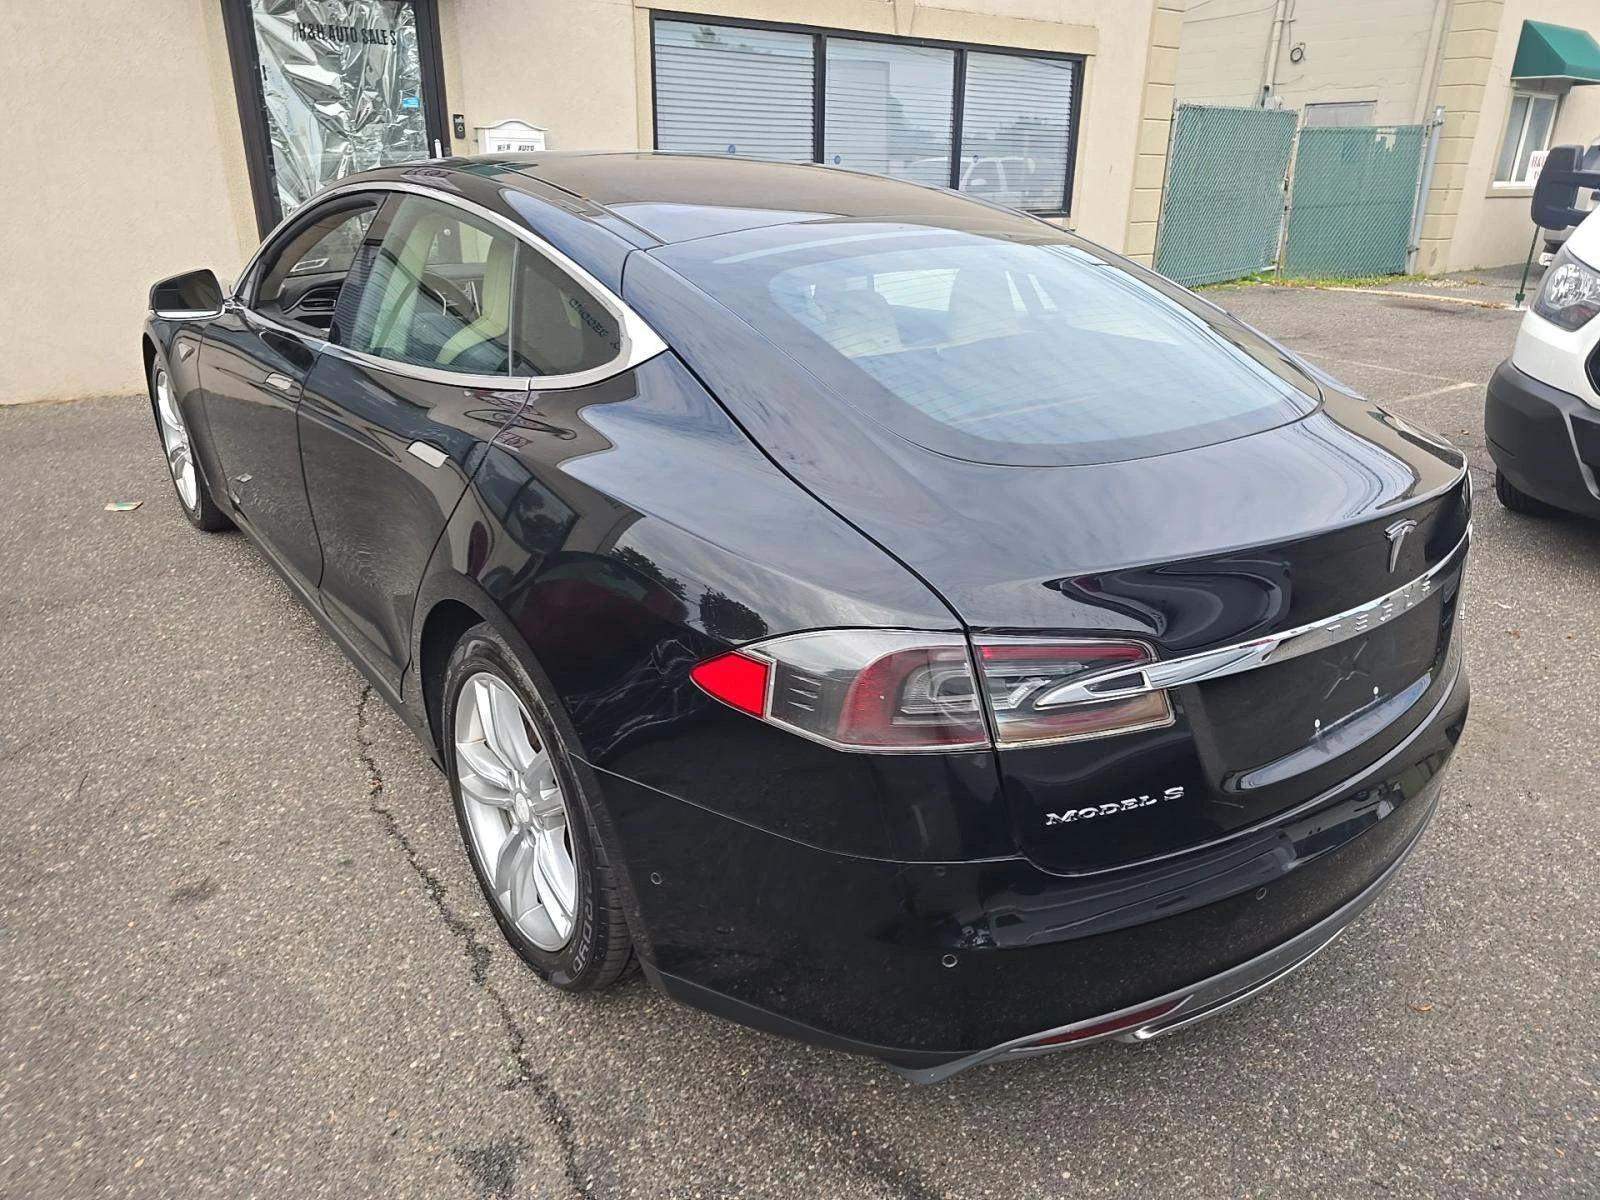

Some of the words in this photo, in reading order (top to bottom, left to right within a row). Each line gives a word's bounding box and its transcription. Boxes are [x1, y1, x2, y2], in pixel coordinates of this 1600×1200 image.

[328, 24, 358, 43] AUTO
[361, 27, 397, 46] SALES
[1326, 577, 1432, 640] TESLA
[1046, 795, 1157, 825] MODEL
[1164, 786, 1184, 801] S
